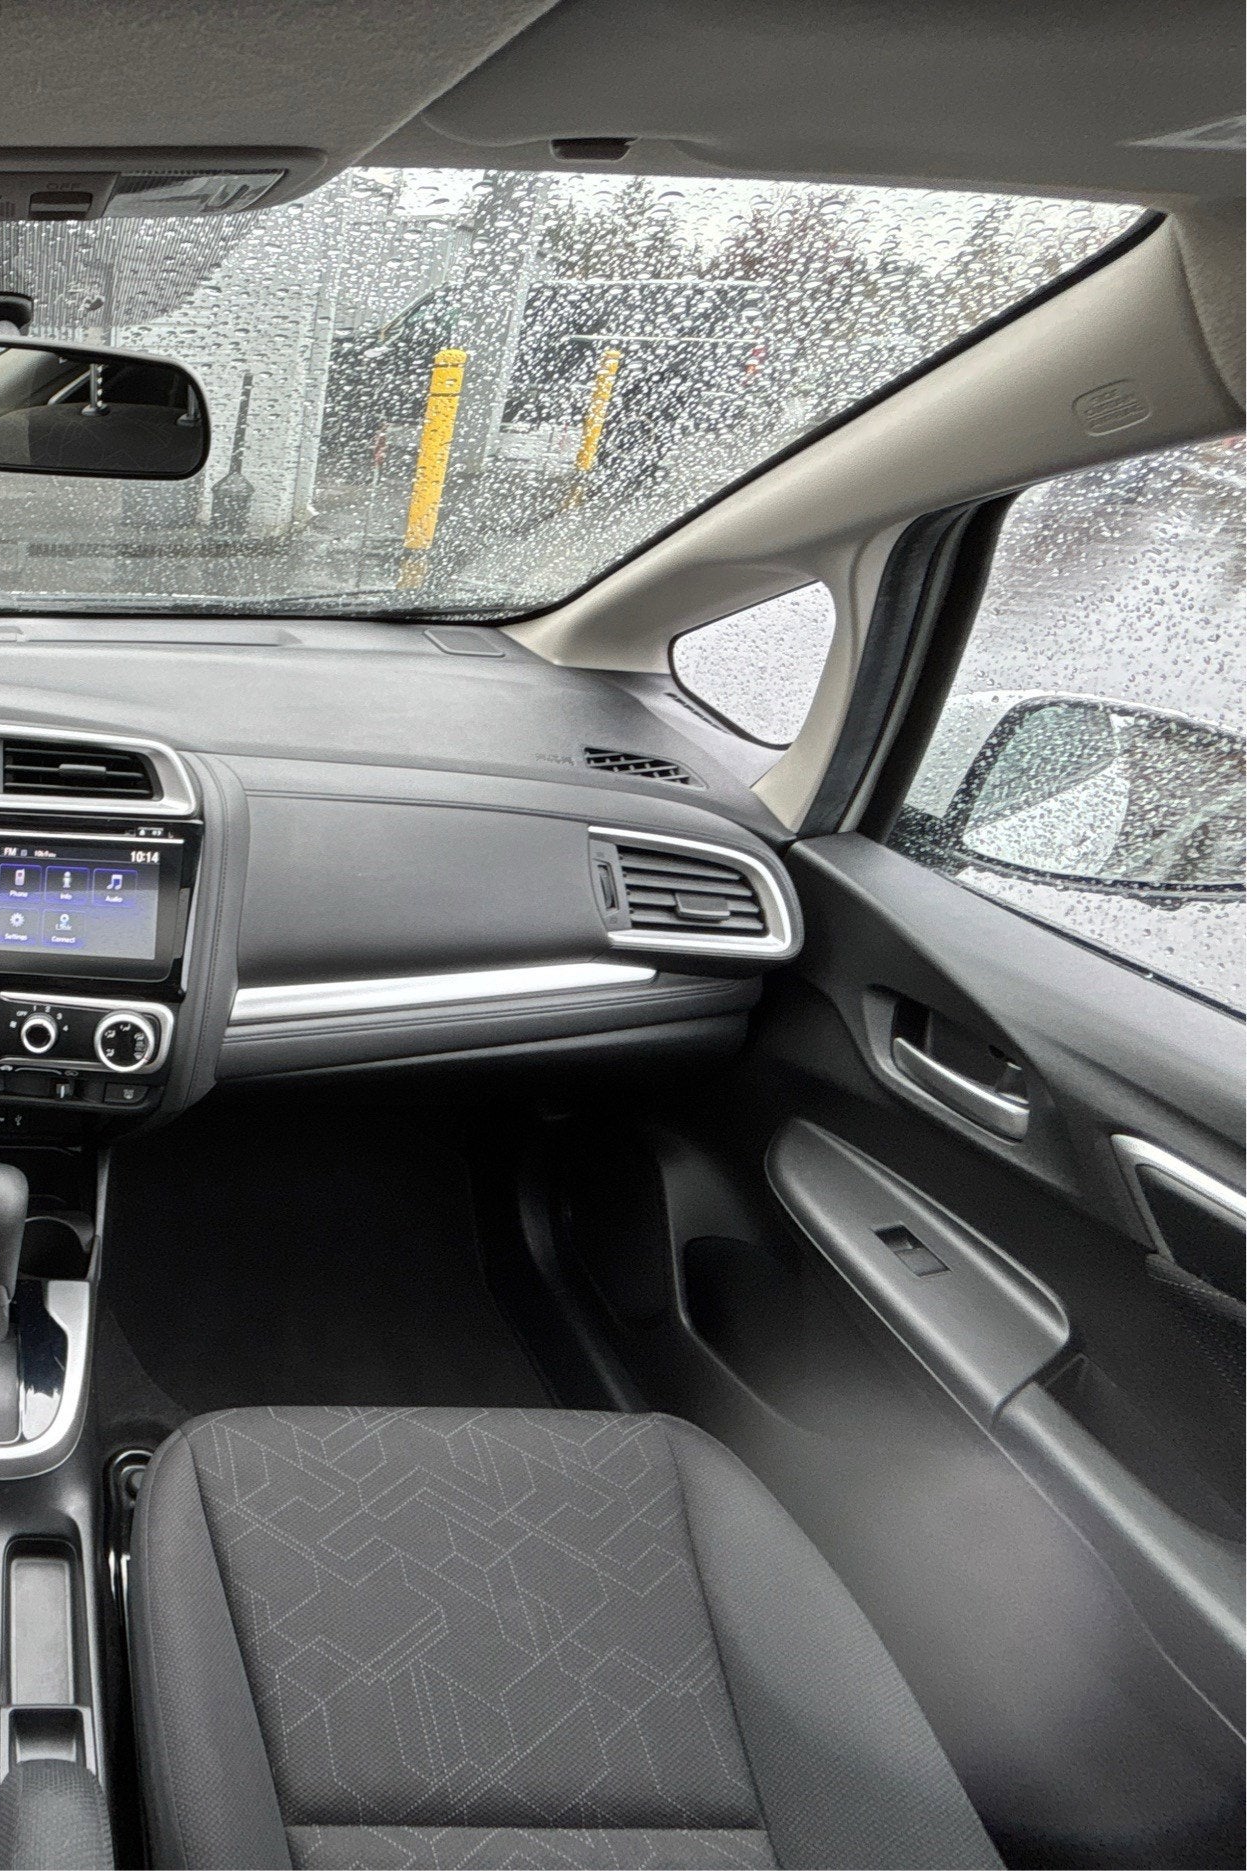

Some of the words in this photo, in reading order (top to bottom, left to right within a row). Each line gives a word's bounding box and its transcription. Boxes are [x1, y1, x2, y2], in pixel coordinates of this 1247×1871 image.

[46, 182, 81, 190] OFF
[4, 847, 17, 856] FM
[130, 851, 159, 863] 10:14
[9, 890, 28, 898] Phone
[105, 895, 123, 903] Audio
[4, 932, 28, 942] Settings
[51, 936, 76, 944] Connect
